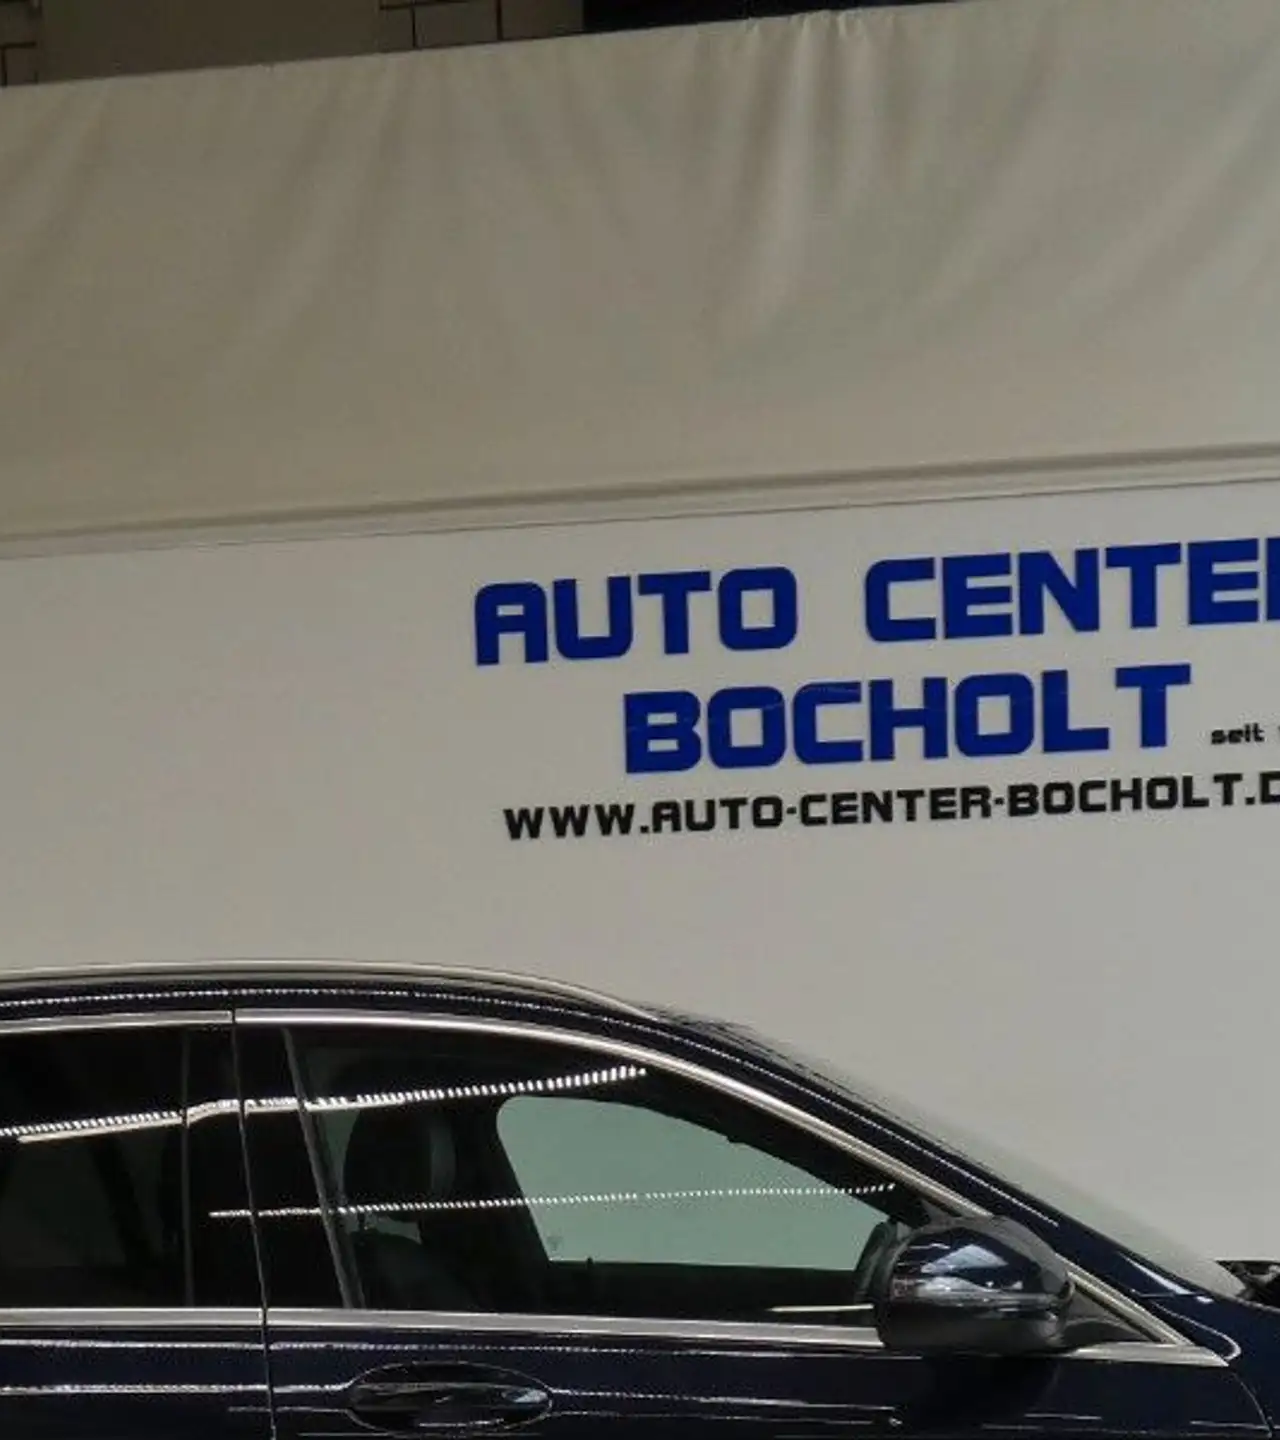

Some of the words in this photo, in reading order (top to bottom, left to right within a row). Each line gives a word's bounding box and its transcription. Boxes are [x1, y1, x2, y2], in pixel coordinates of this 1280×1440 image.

[475, 566, 798, 667] AUTO
[623, 663, 1193, 774] BOCHOLT
[1210, 722, 1266, 745] seit
